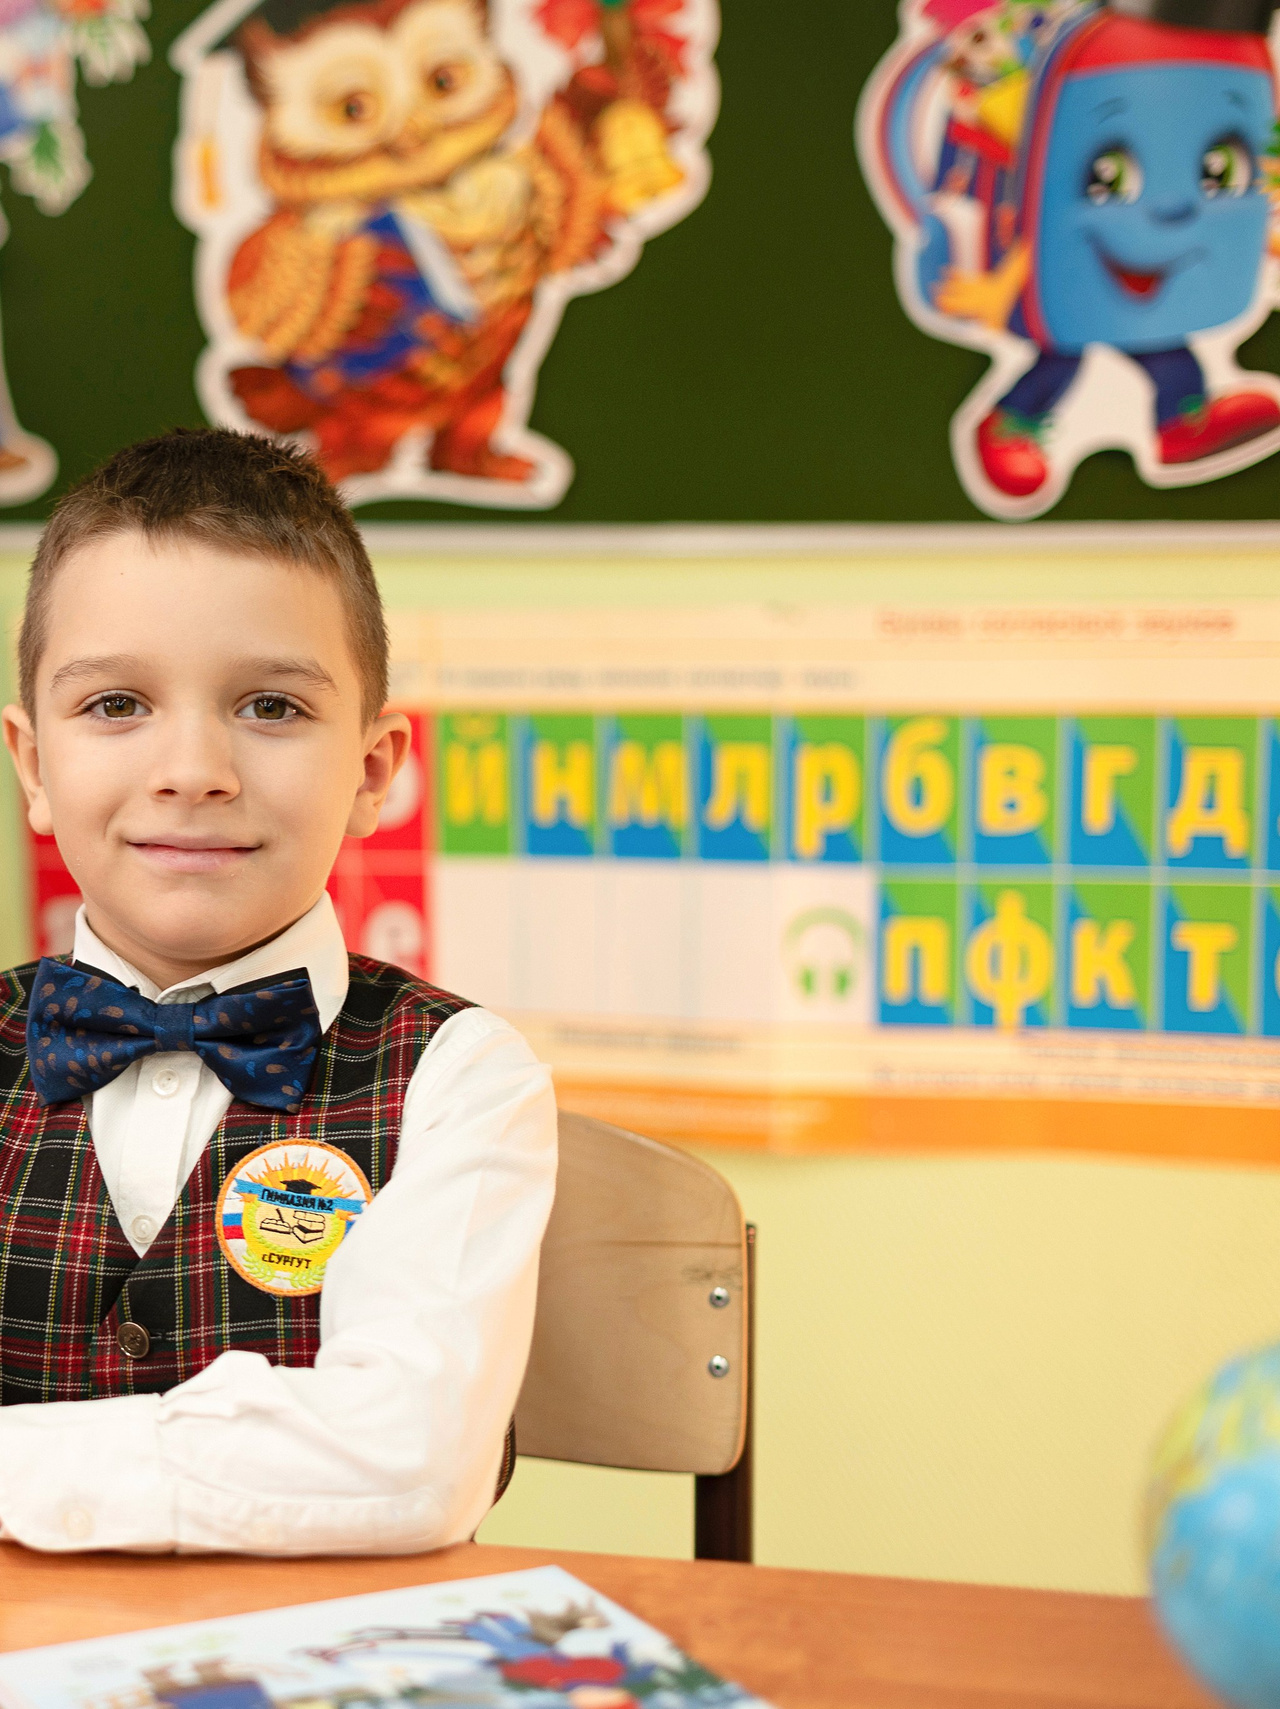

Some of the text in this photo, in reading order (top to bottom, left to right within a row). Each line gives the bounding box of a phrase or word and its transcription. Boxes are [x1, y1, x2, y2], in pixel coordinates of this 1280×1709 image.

[443, 714, 1252, 858] й н м л р б в г д
[884, 888, 1240, 1034] п ф к т
